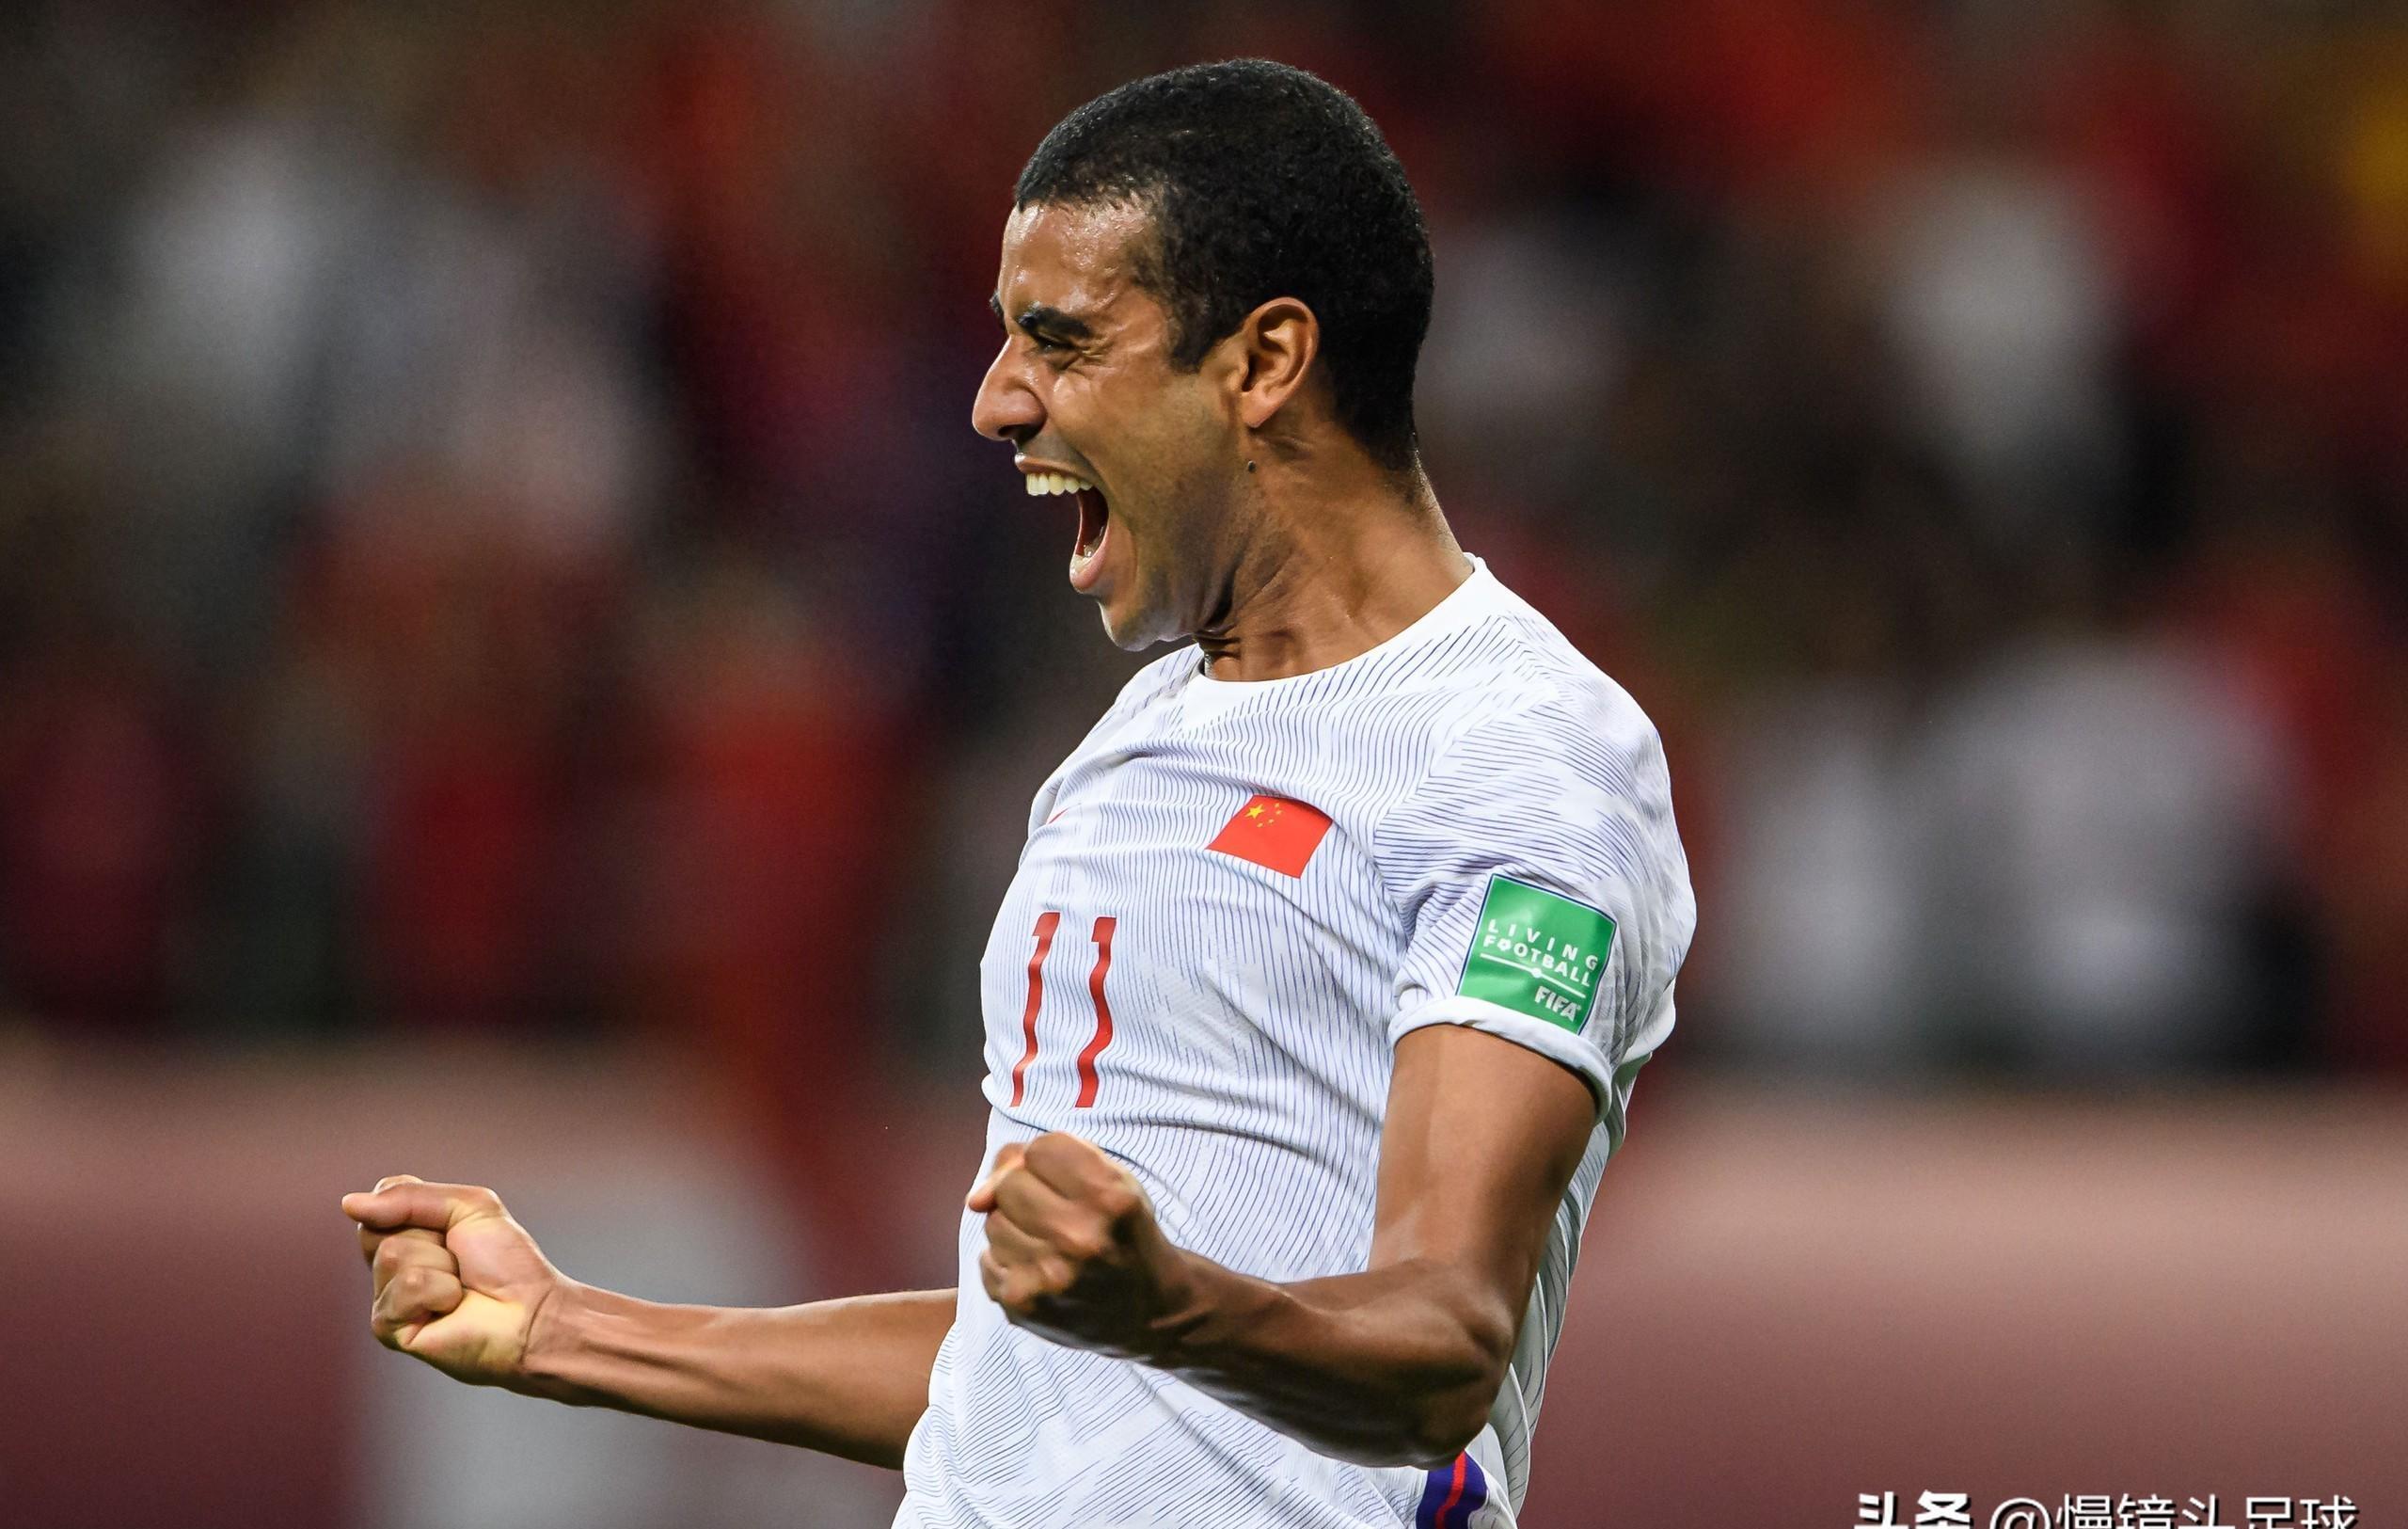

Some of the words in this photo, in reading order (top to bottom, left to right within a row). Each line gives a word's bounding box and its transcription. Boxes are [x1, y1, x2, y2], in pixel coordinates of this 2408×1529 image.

[1482, 934, 1591, 987] FOOTBALL
[1487, 918, 1599, 970] LIVING
[1009, 911, 1117, 1107] 11
[1534, 985, 1577, 1022] FIFA
